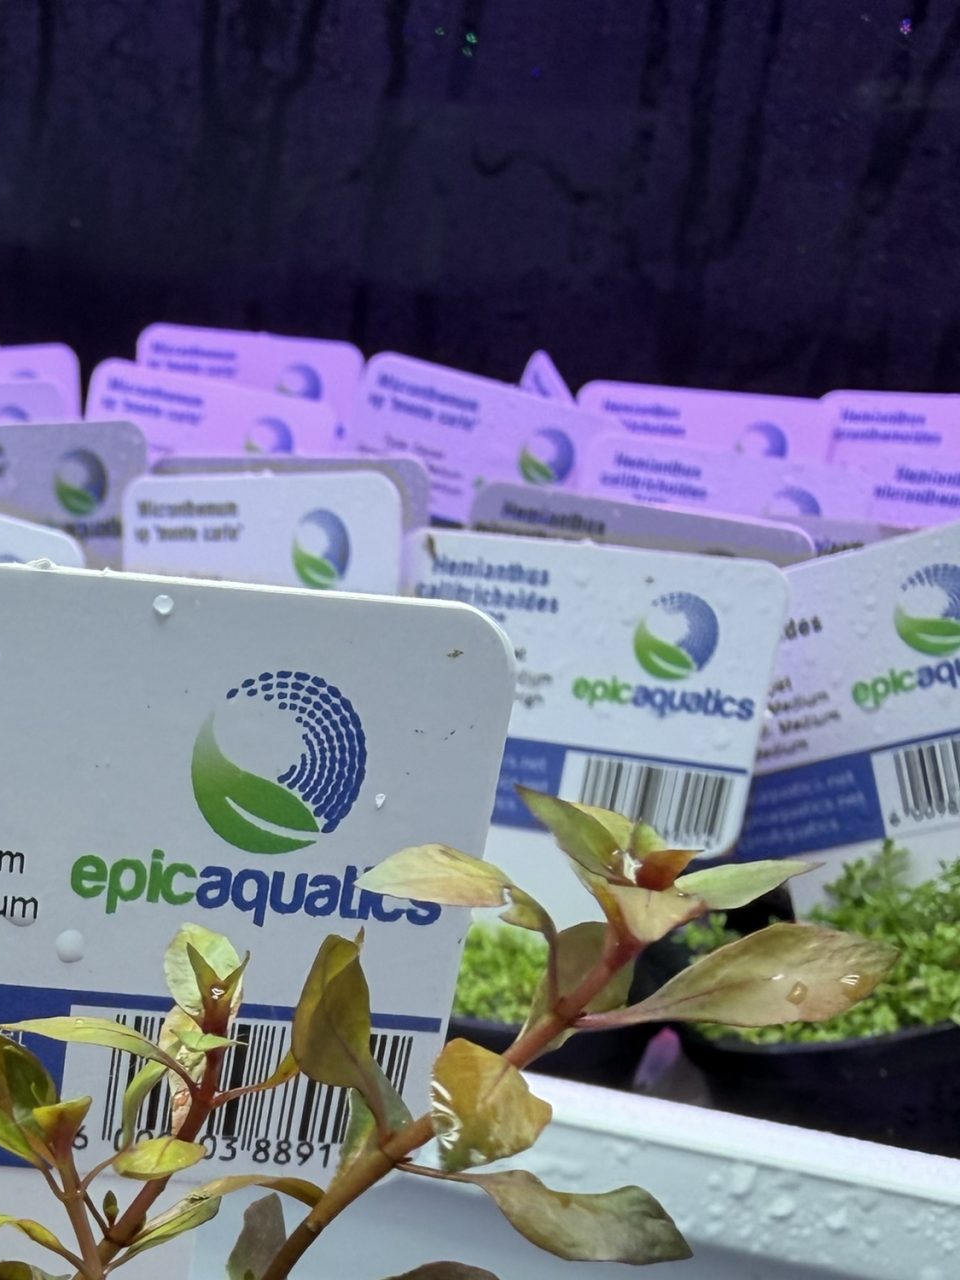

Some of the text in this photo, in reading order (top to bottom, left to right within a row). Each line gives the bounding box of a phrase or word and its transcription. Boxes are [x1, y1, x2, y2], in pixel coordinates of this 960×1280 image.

[571, 675, 755, 722] epicaquatics
[70, 848, 442, 927] epicaquatics
[251, 1138, 332, 1168] 8891
